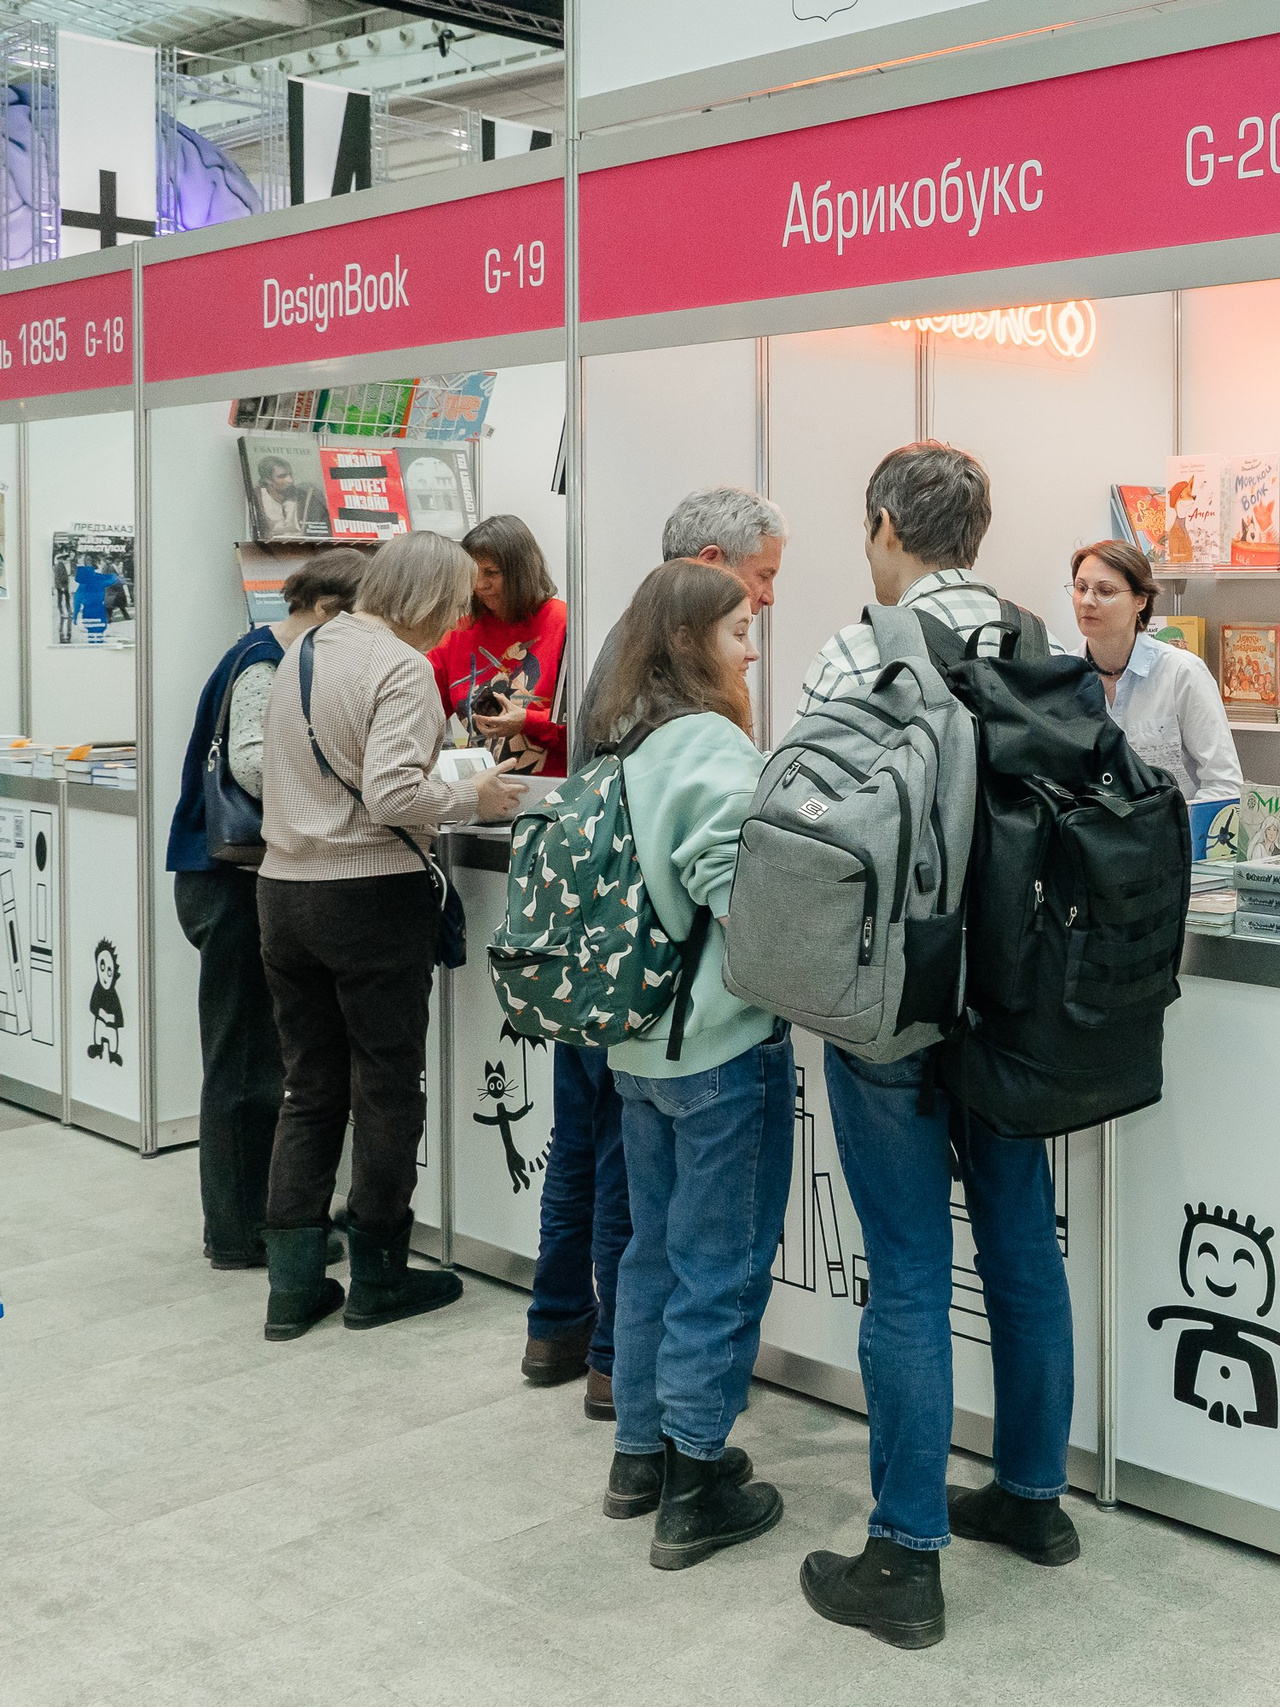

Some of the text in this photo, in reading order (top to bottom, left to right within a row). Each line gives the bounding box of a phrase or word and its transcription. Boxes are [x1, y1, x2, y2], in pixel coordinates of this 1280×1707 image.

[781, 155, 1045, 256] Абрикобукс
[484, 240, 545, 295] G-19
[262, 254, 410, 333] DesignBook
[18, 315, 67, 367] 1895
[84, 316, 124, 358] G-18
[337, 451, 382, 467] ДИЗАЙН
[339, 478, 387, 493] ПРОТЕСТ
[344, 494, 390, 510] ДИЗАЙН
[73, 522, 135, 534] ПРЕДЗАКАЗ
